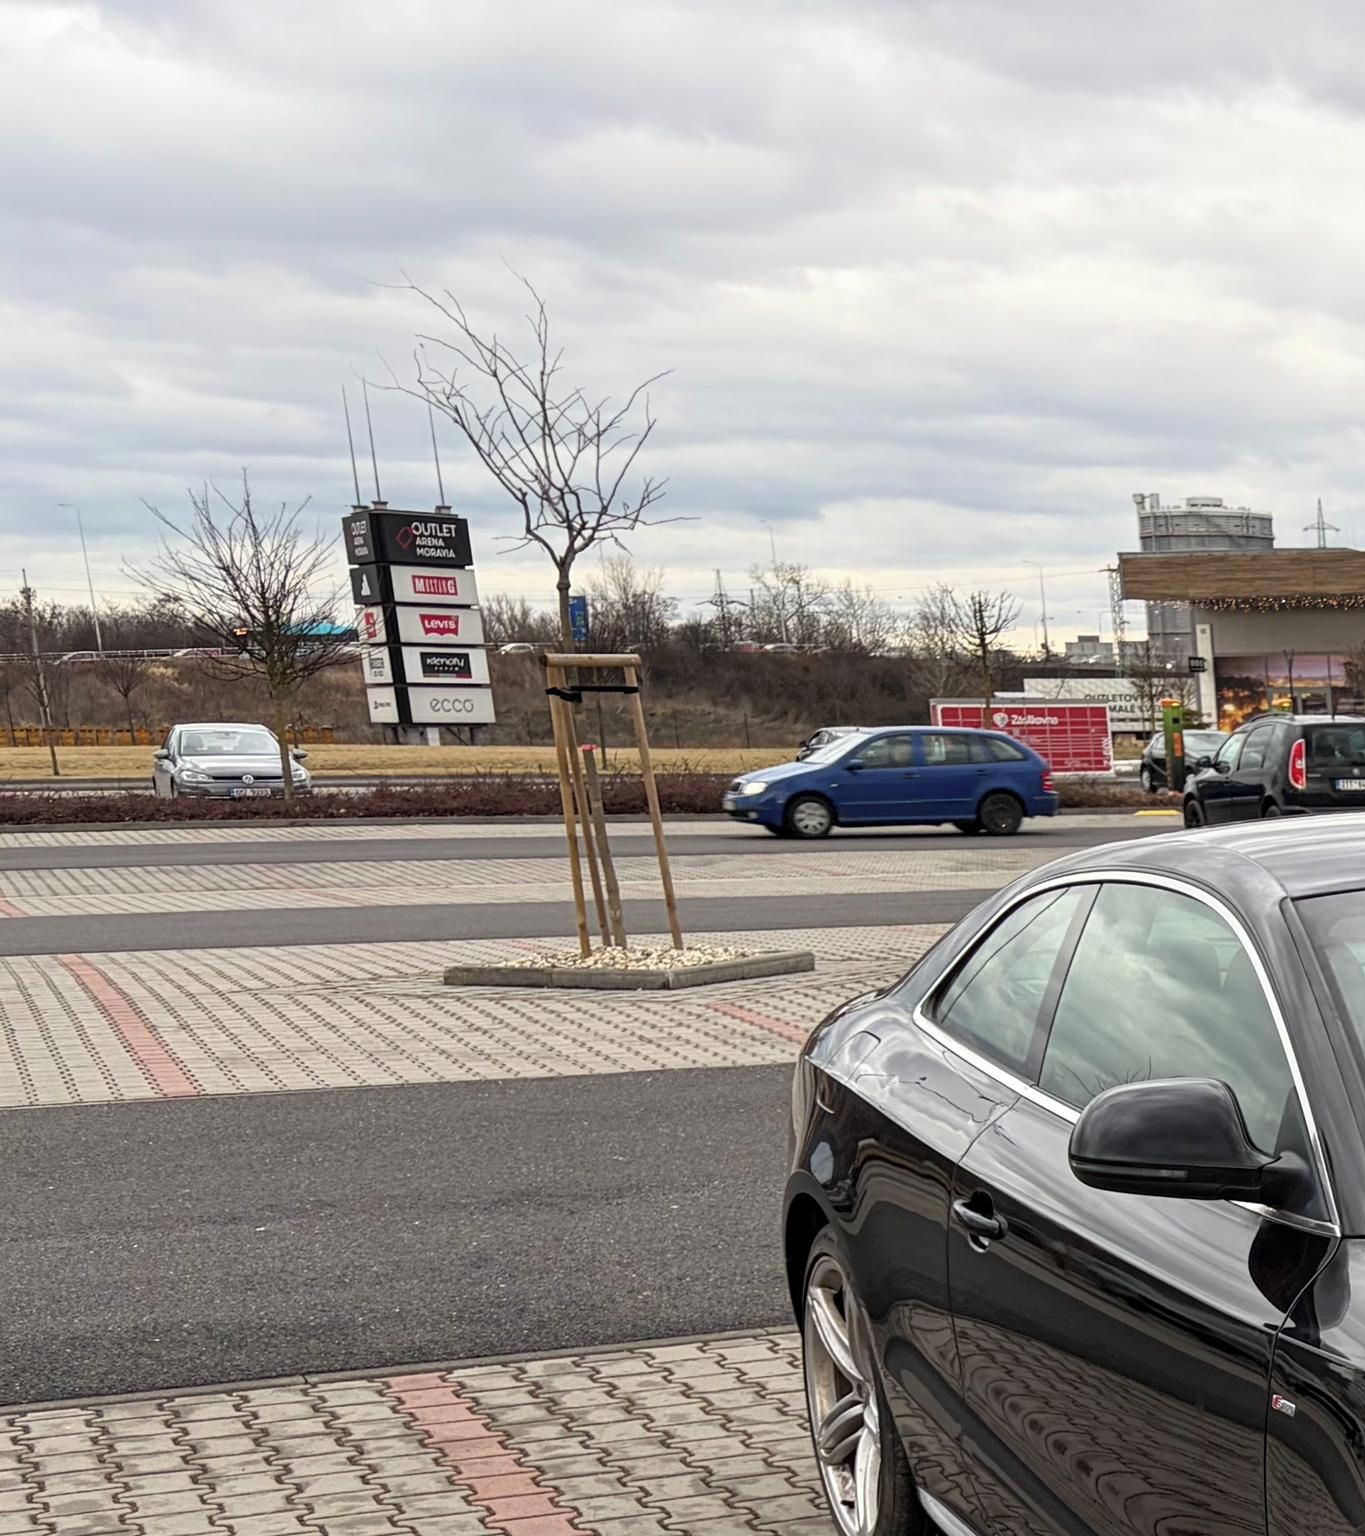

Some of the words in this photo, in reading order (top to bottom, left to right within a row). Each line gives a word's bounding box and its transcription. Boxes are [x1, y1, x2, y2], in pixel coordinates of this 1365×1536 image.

[411, 521, 456, 538] OUTLET
[415, 537, 445, 547] ARENA
[416, 547, 456, 559] MORAVIA
[430, 698, 475, 713] ecco
